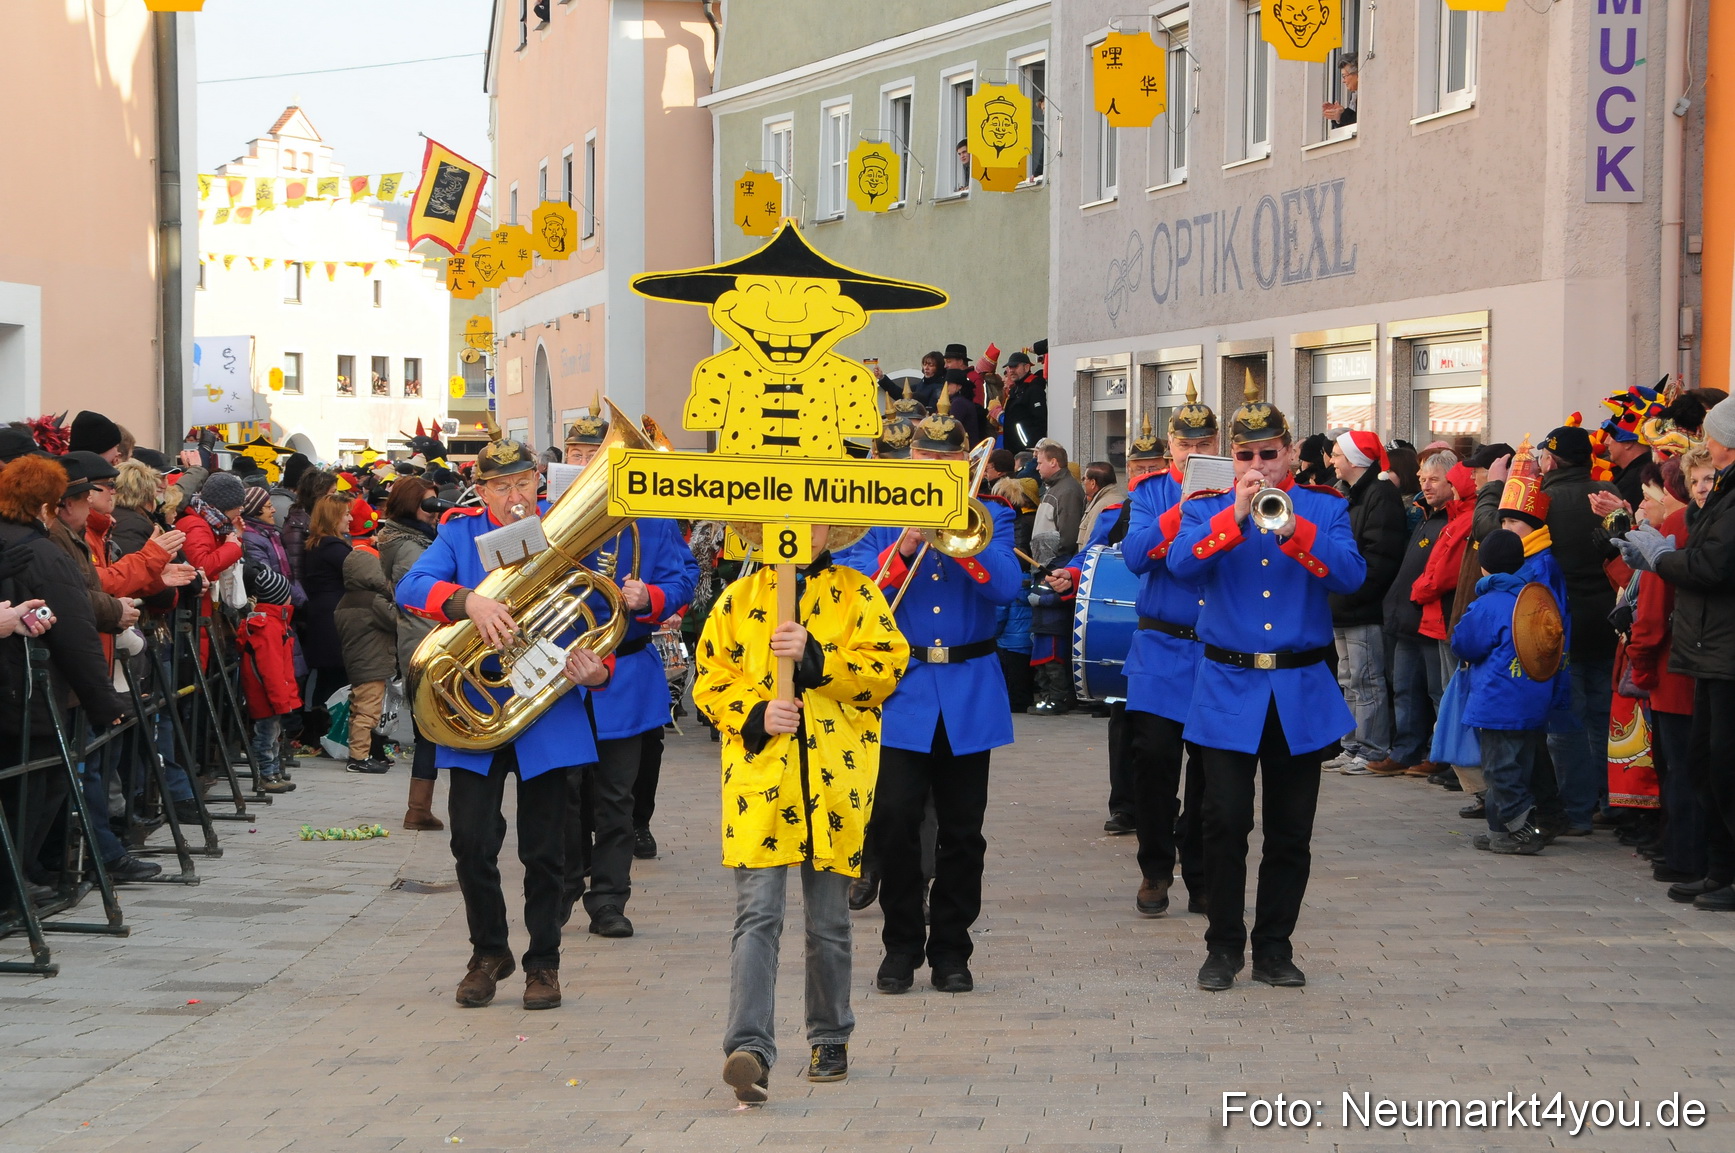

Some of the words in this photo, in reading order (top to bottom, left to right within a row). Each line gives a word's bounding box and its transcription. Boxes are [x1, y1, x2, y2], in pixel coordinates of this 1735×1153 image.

[1140, 75, 1158, 97] 华
[1105, 97, 1121, 115] 人
[764, 201, 777, 216] 华
[741, 215, 752, 227] 人
[1151, 205, 1244, 305] OPTIK
[1253, 177, 1357, 290] OEXL
[450, 277, 463, 292] 人
[1331, 355, 1369, 378] BRILLEN
[627, 470, 793, 506] Blaskapelle
[804, 477, 944, 507] Mühlbach
[778, 529, 798, 559] 8
